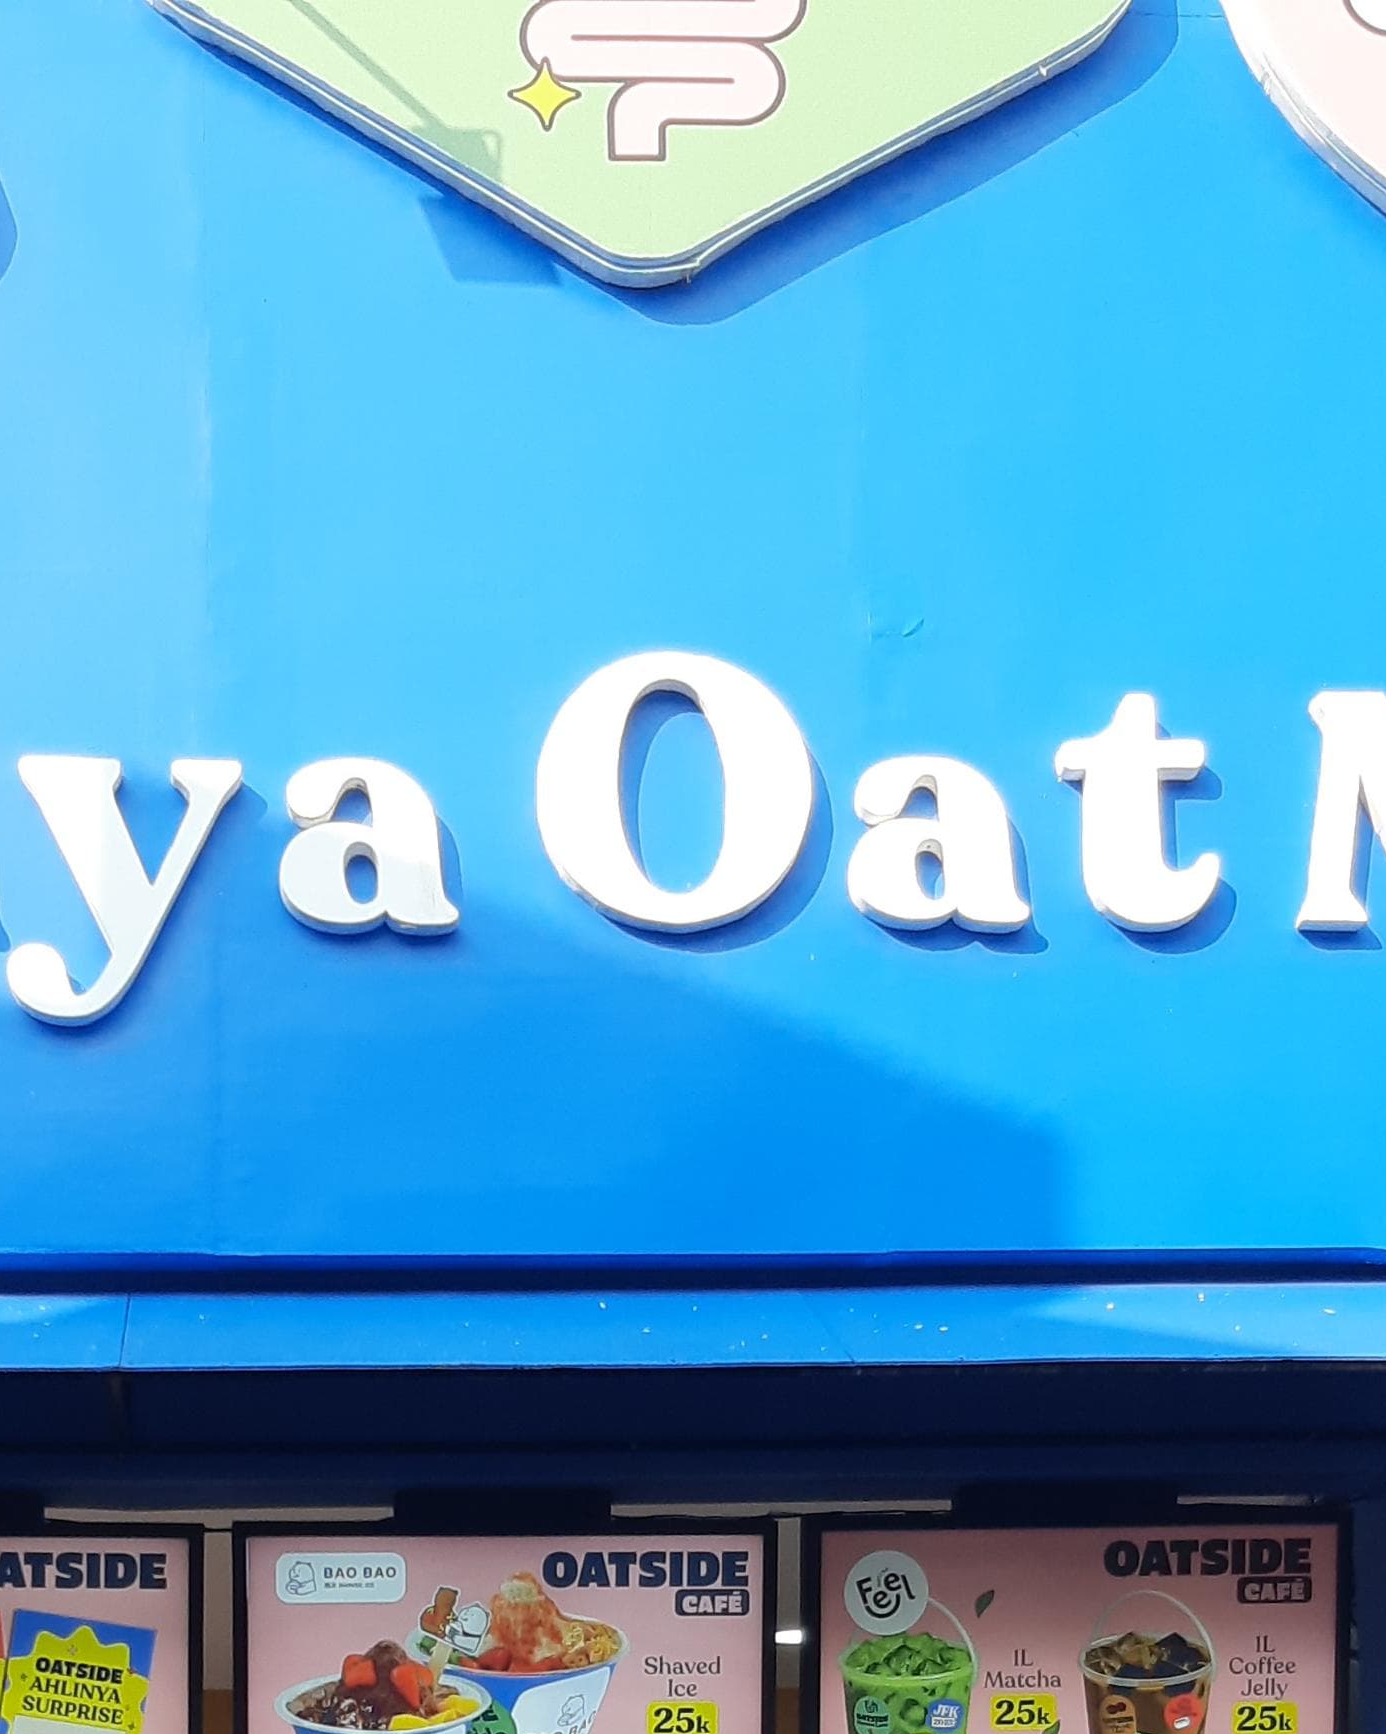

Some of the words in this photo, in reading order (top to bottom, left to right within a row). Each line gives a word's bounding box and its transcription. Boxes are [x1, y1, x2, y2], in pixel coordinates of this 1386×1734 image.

[536, 650, 1225, 933] Oat
[543, 1551, 749, 1588] OATSIDE
[1104, 1538, 1312, 1577] OATSIDE
[324, 1567, 357, 1579] BAO
[363, 1567, 397, 1579] BAO
[1244, 1578, 1305, 1600] CAFÉ
[682, 1592, 743, 1614] CAFÉ
[36, 1657, 123, 1684] OATSIDE
[644, 1655, 721, 1675] Shaved
[1229, 1656, 1296, 1675] Coffee
[29, 1676, 121, 1704] AHLINYA
[668, 1679, 698, 1697] Ice
[984, 1671, 1062, 1689] Matcha
[1241, 1679, 1288, 1700] Jelly
[23, 1694, 123, 1725] SURPRISE
[653, 1708, 710, 1734] 25k
[995, 1699, 1051, 1726] 25k
[1237, 1706, 1293, 1732] 25k
